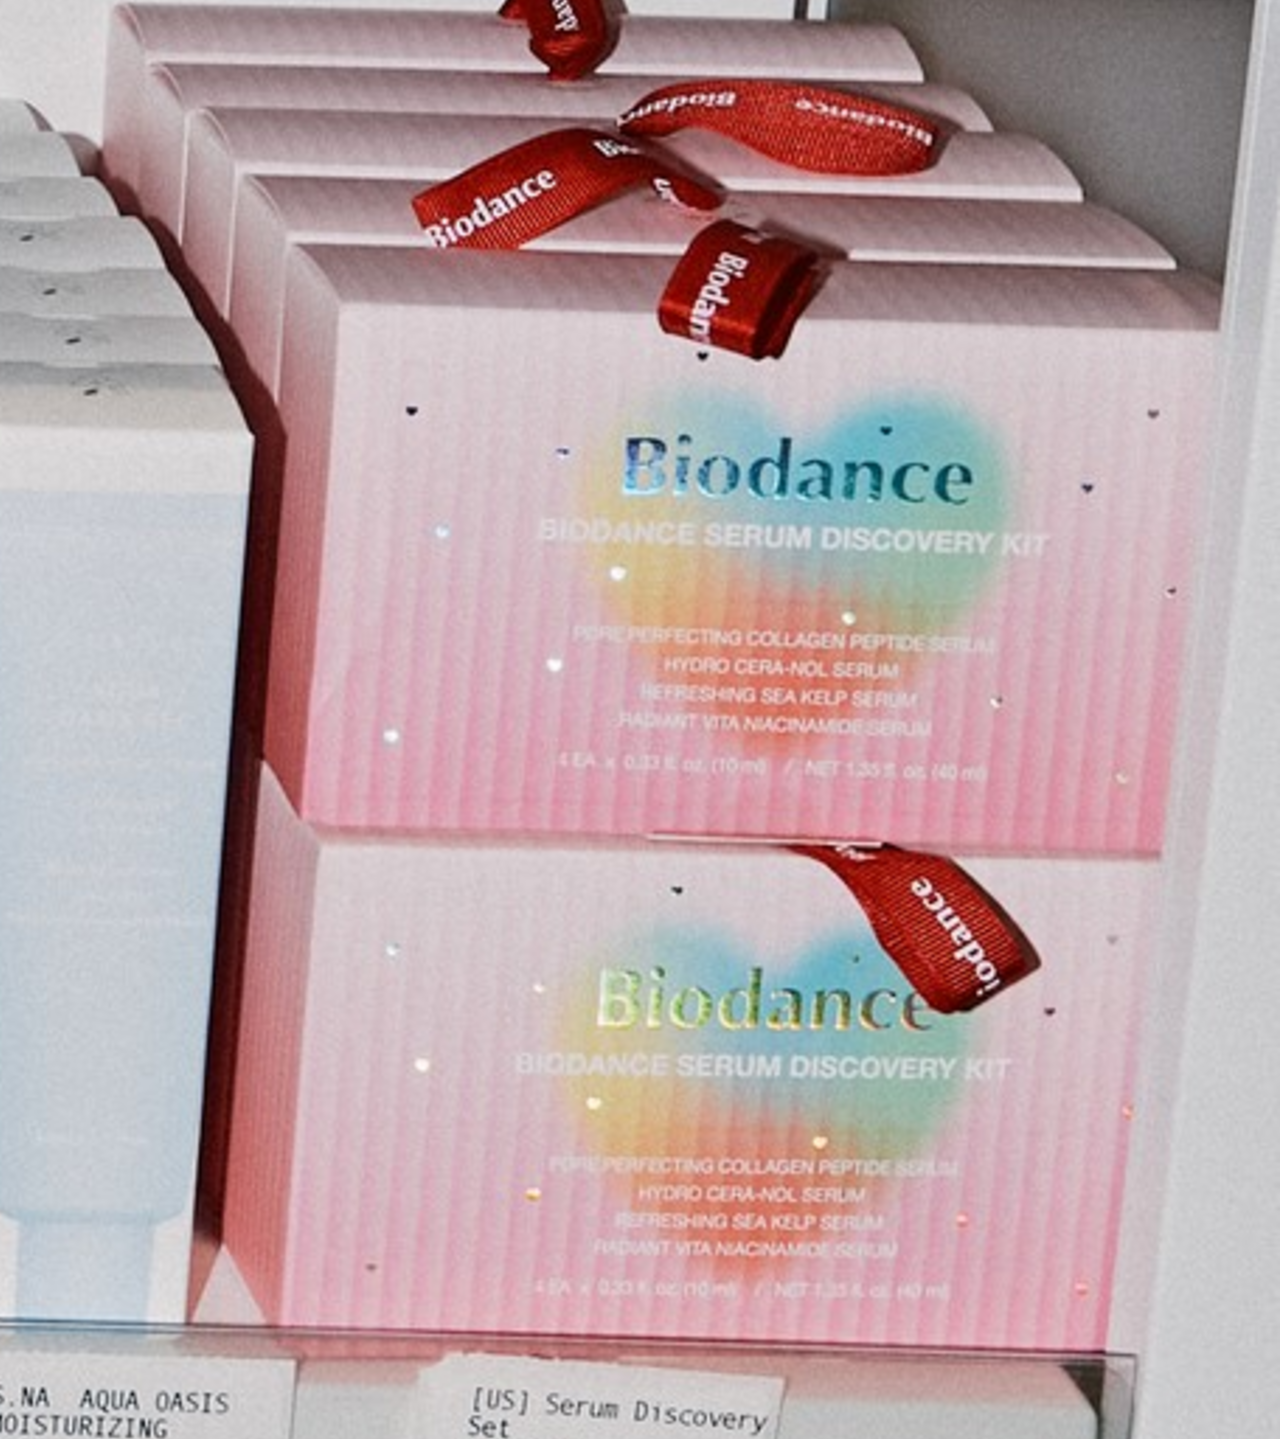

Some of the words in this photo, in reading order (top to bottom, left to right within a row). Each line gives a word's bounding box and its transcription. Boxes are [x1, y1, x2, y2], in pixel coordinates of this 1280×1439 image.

[423, 166, 558, 251] Biodance
[621, 434, 974, 506] Biodance
[538, 518, 696, 548] BIODANCE
[703, 522, 812, 552] SERUM
[820, 525, 994, 557] DISCOVERY
[1001, 529, 1050, 558] KIT
[79, 1389, 140, 1413] AQUA
[155, 1391, 230, 1415] OASIS
[472, 1386, 530, 1414] [US]
[545, 1392, 619, 1420] Serum
[634, 1400, 769, 1436] Discovery
[468, 1417, 511, 1439] Set
